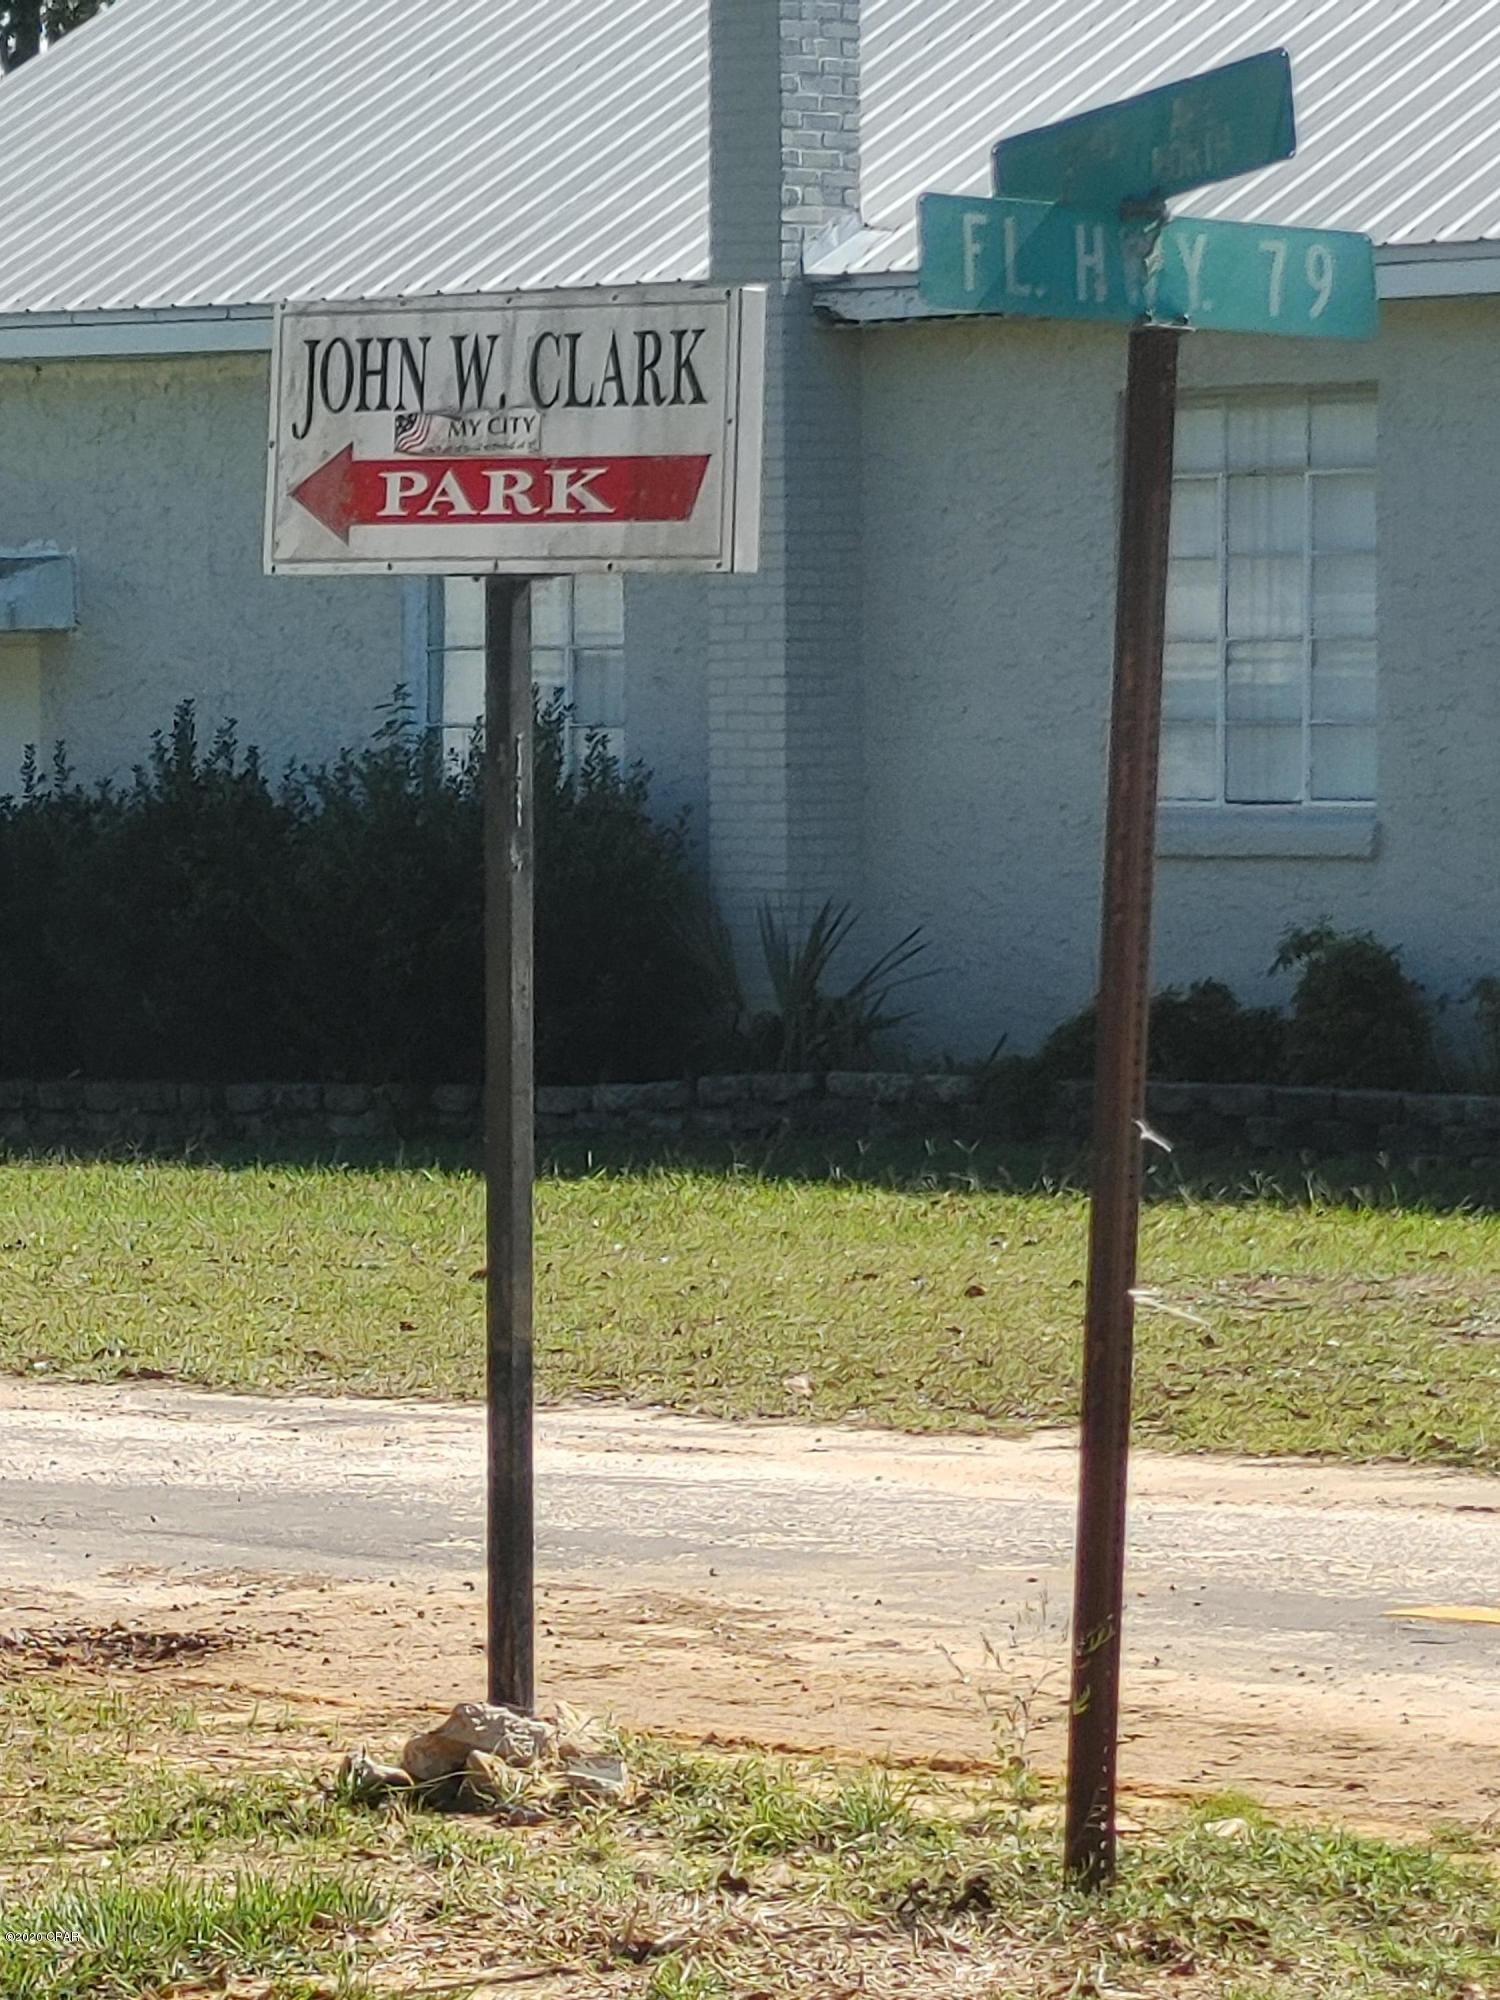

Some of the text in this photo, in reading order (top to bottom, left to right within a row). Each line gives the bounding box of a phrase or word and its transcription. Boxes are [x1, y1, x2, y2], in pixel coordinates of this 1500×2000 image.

[961, 212, 1047, 299] FL.
[1257, 238, 1336, 321] 79
[291, 327, 709, 441] JOHN W. CLARK
[447, 413, 537, 438] MY CITY
[376, 466, 617, 518] PARK
